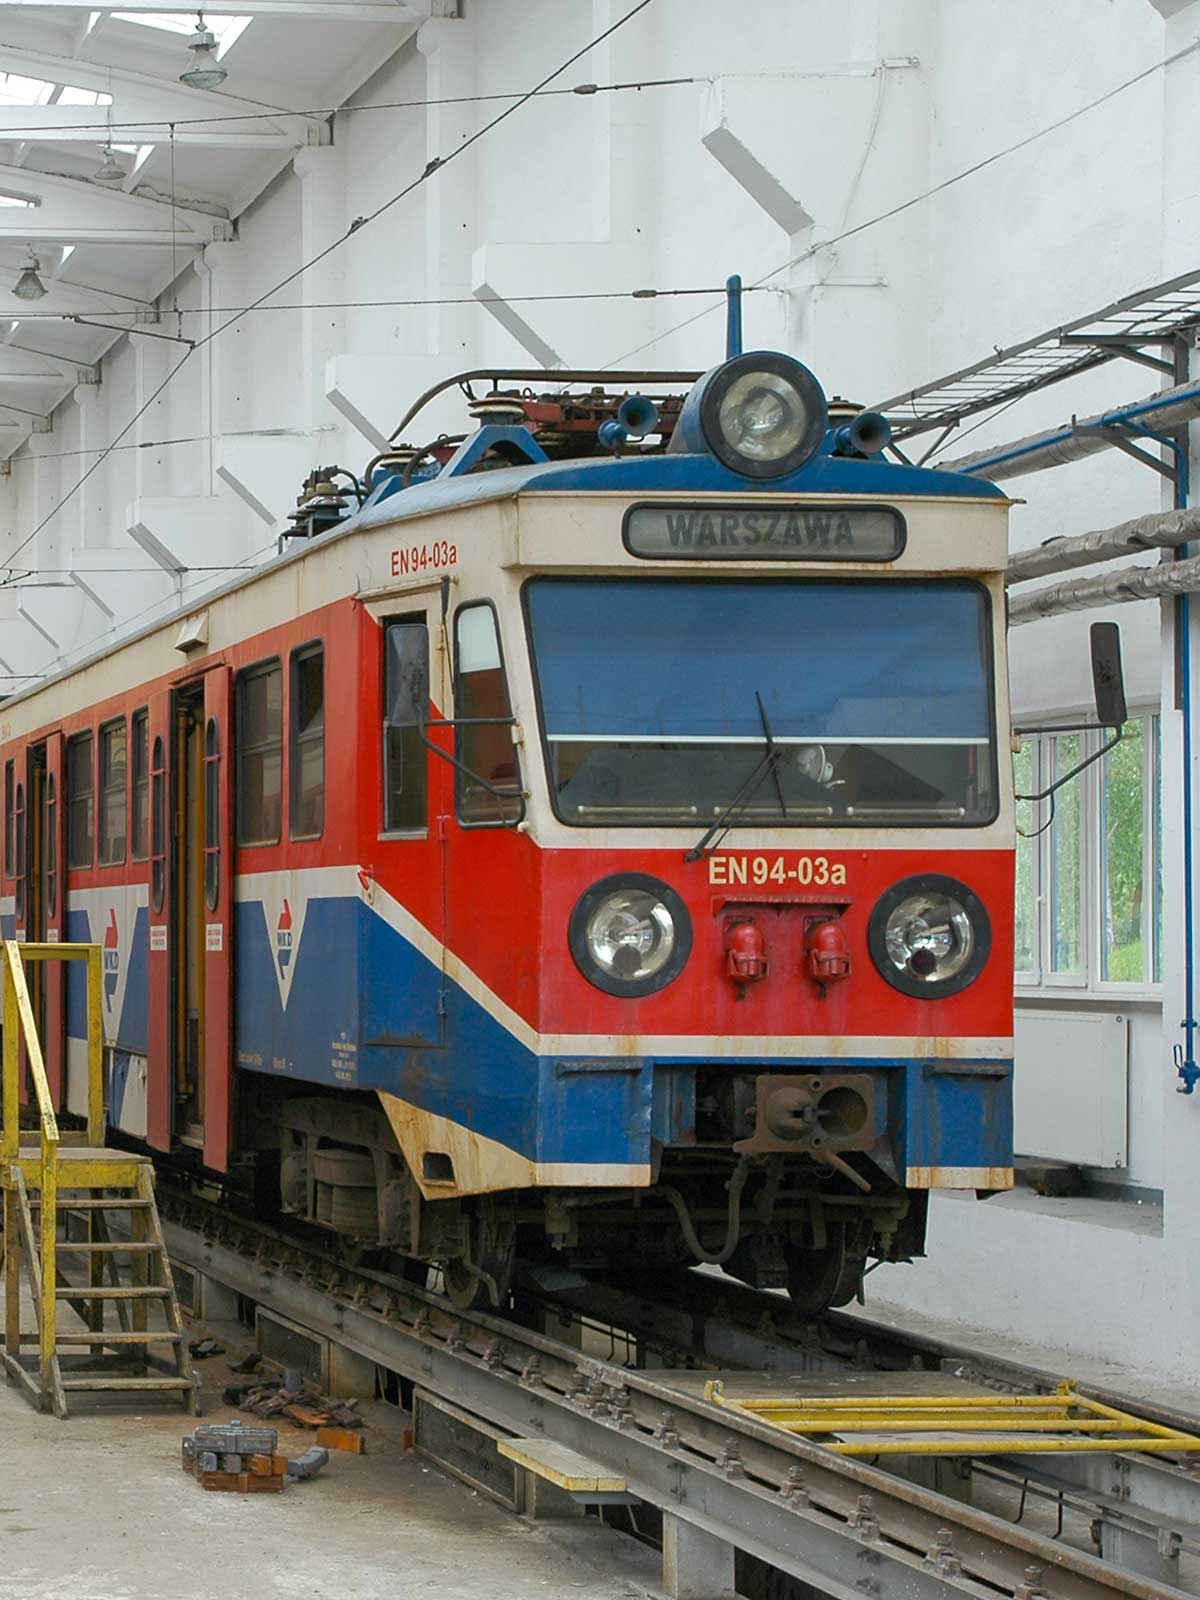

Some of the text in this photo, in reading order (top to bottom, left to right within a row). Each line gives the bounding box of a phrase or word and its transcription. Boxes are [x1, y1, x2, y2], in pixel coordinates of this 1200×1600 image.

[665, 512, 854, 546] WARSZAWA
[708, 856, 848, 885] EN 94-03a
